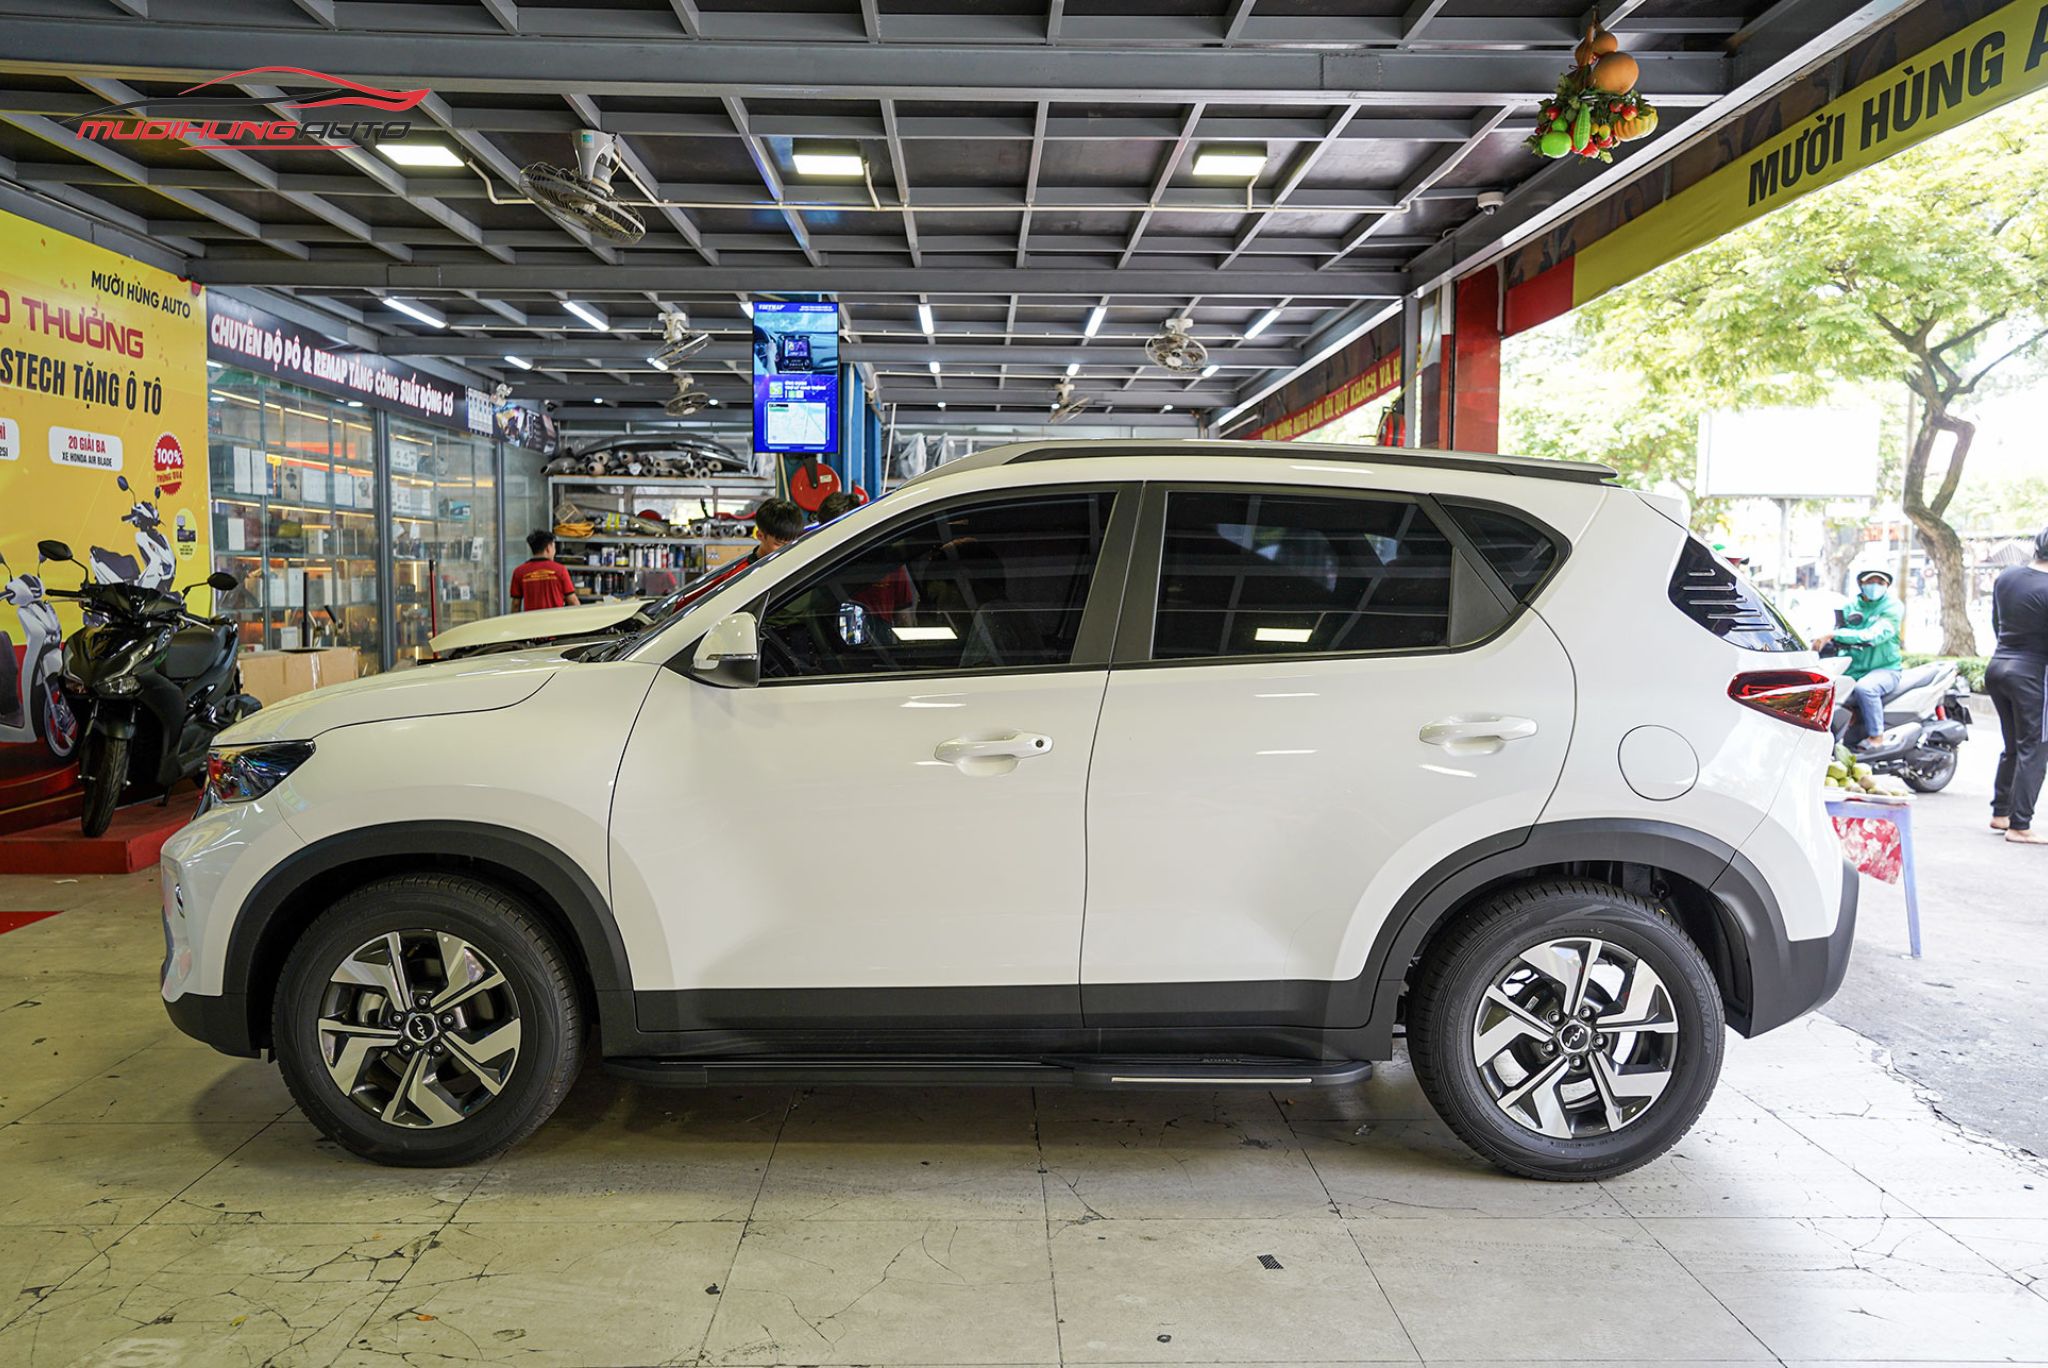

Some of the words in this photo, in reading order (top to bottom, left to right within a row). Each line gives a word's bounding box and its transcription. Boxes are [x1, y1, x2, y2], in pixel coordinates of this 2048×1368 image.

[1748, 113, 1846, 207] MƯỜI
[1860, 31, 2006, 151] HÙNG
[91, 270, 124, 297] MƯỜI
[127, 278, 160, 309] HÙNG
[161, 295, 191, 319] AUTO
[21, 296, 144, 359] THƯỞNG
[0, 347, 66, 396] STECH
[73, 361, 120, 409] TẶNG
[126, 370, 137, 411] Ô
[143, 376, 163, 416] TÔ
[210, 313, 263, 359] CHUYÊN
[263, 328, 283, 373] ĐỘ
[284, 334, 301, 371] PÔ
[302, 345, 313, 375] &
[313, 348, 348, 385] REMAP
[374, 368, 400, 401] CÔNG
[1350, 370, 1377, 407] KHÁCH
[1379, 359, 1392, 389] VÀ
[62, 451, 69, 462] XE
[70, 452, 87, 464] HONDA
[88, 455, 97, 465] AIR
[68, 435, 78, 450] 20
[96, 439, 106, 454] BA
[157, 447, 182, 466] 100%
